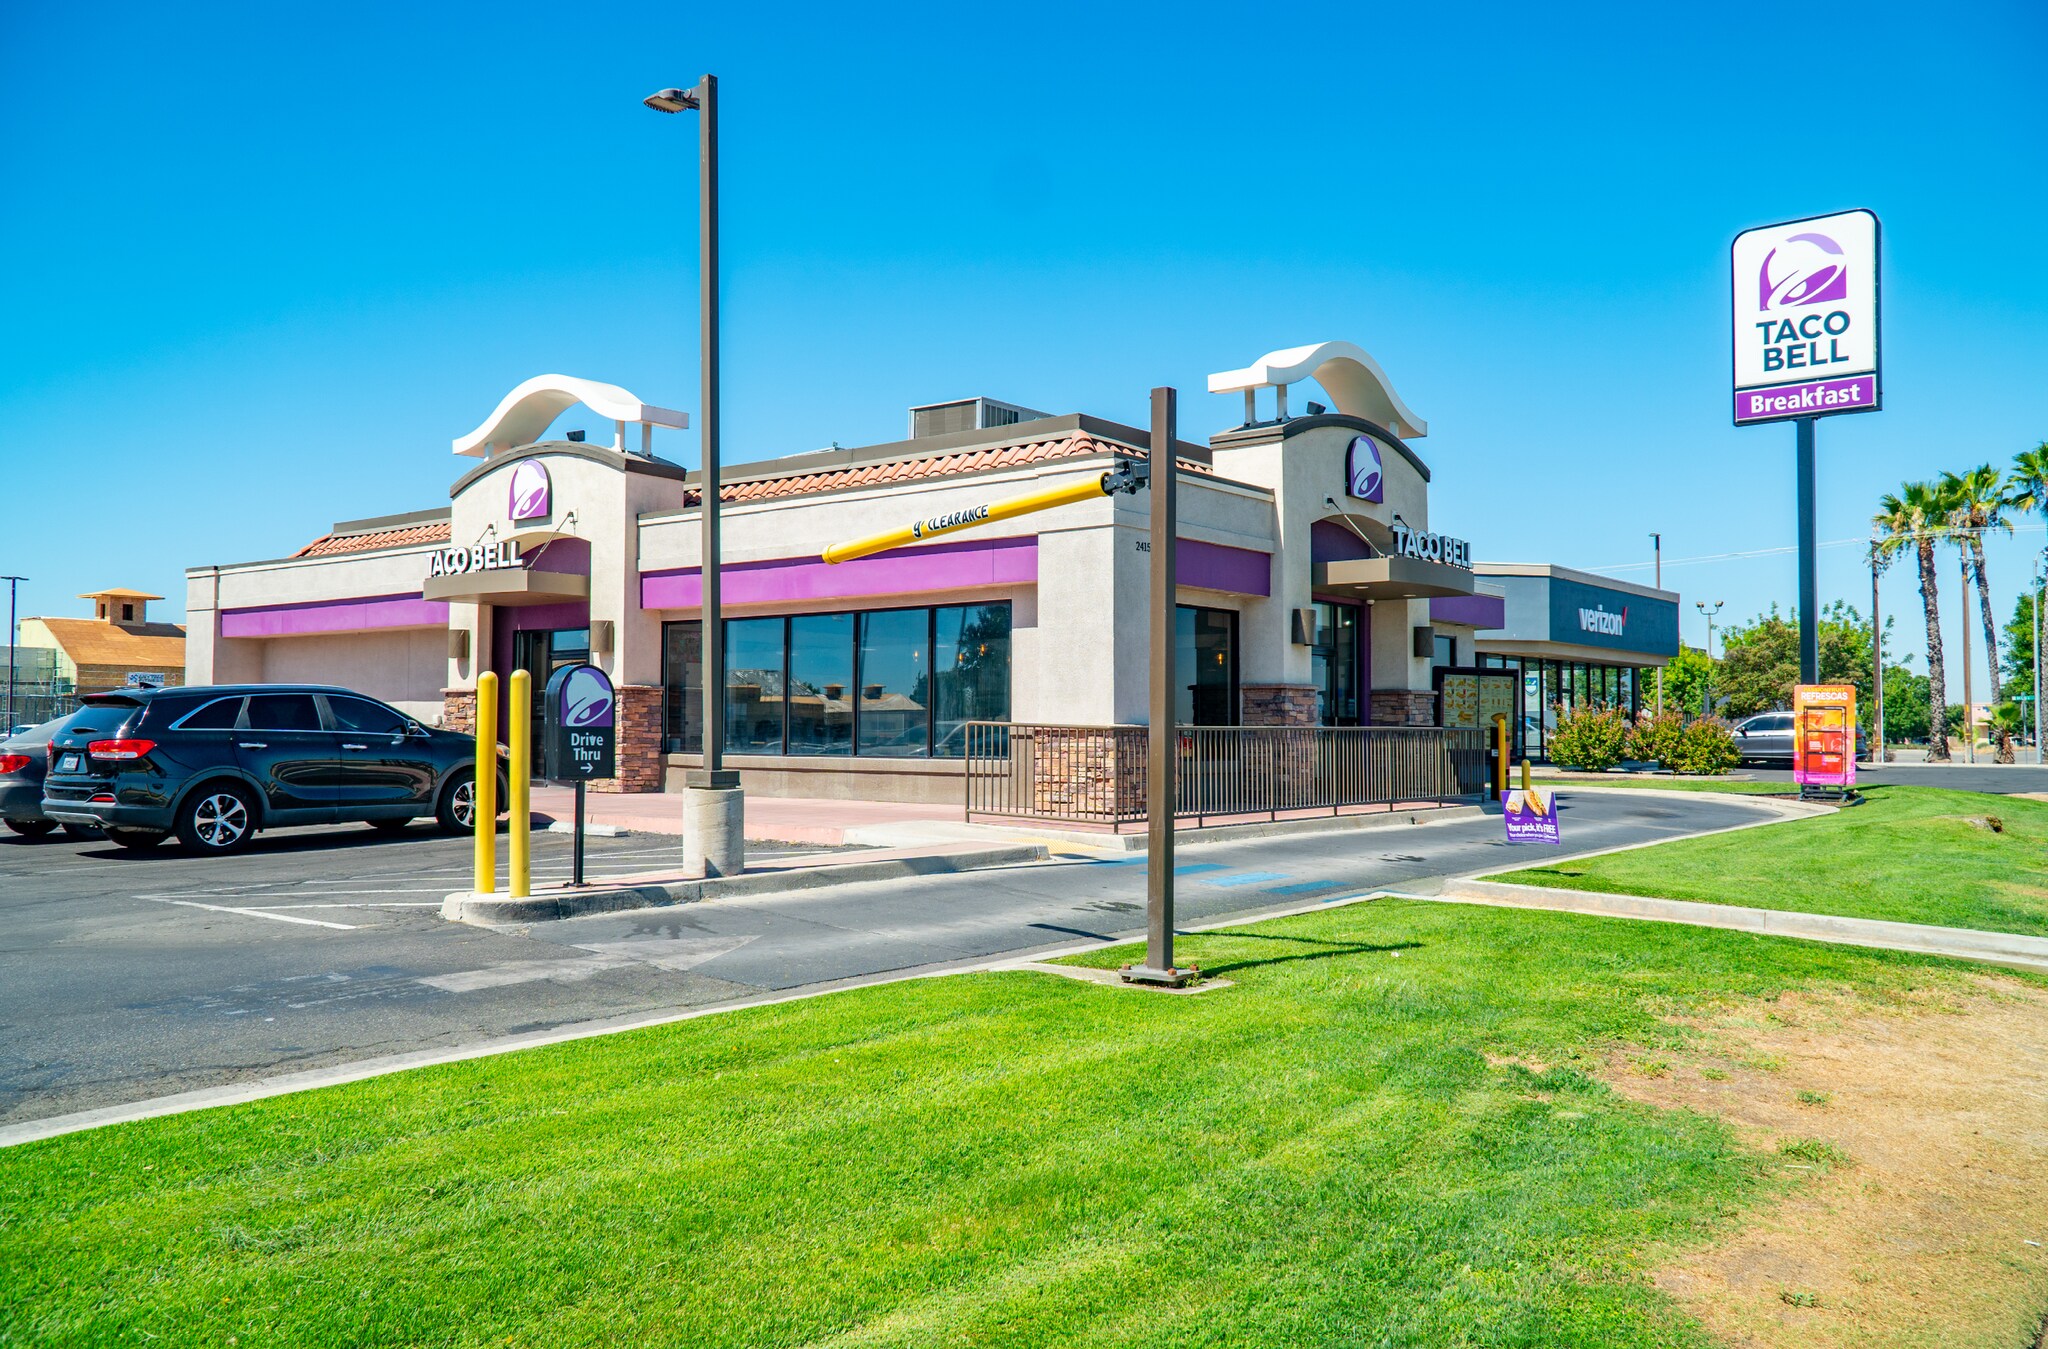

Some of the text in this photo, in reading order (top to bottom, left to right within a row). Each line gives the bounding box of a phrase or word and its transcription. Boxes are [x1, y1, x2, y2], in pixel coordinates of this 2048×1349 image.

[1756, 310, 1850, 345] TACO
[1764, 338, 1849, 372] BELL
[1750, 383, 1860, 414] Breakfast
[927, 504, 989, 531] CLEARANCE
[425, 541, 523, 578] TACO BELL
[1391, 524, 1474, 569] TACO BELL
[1578, 604, 1623, 636] verizon
[1801, 692, 1848, 700] REFRESCAS
[571, 732, 604, 747] Drive
[573, 747, 601, 761] Thru
[1507, 823, 1521, 832] Your
[1543, 824, 1556, 834] FREE
